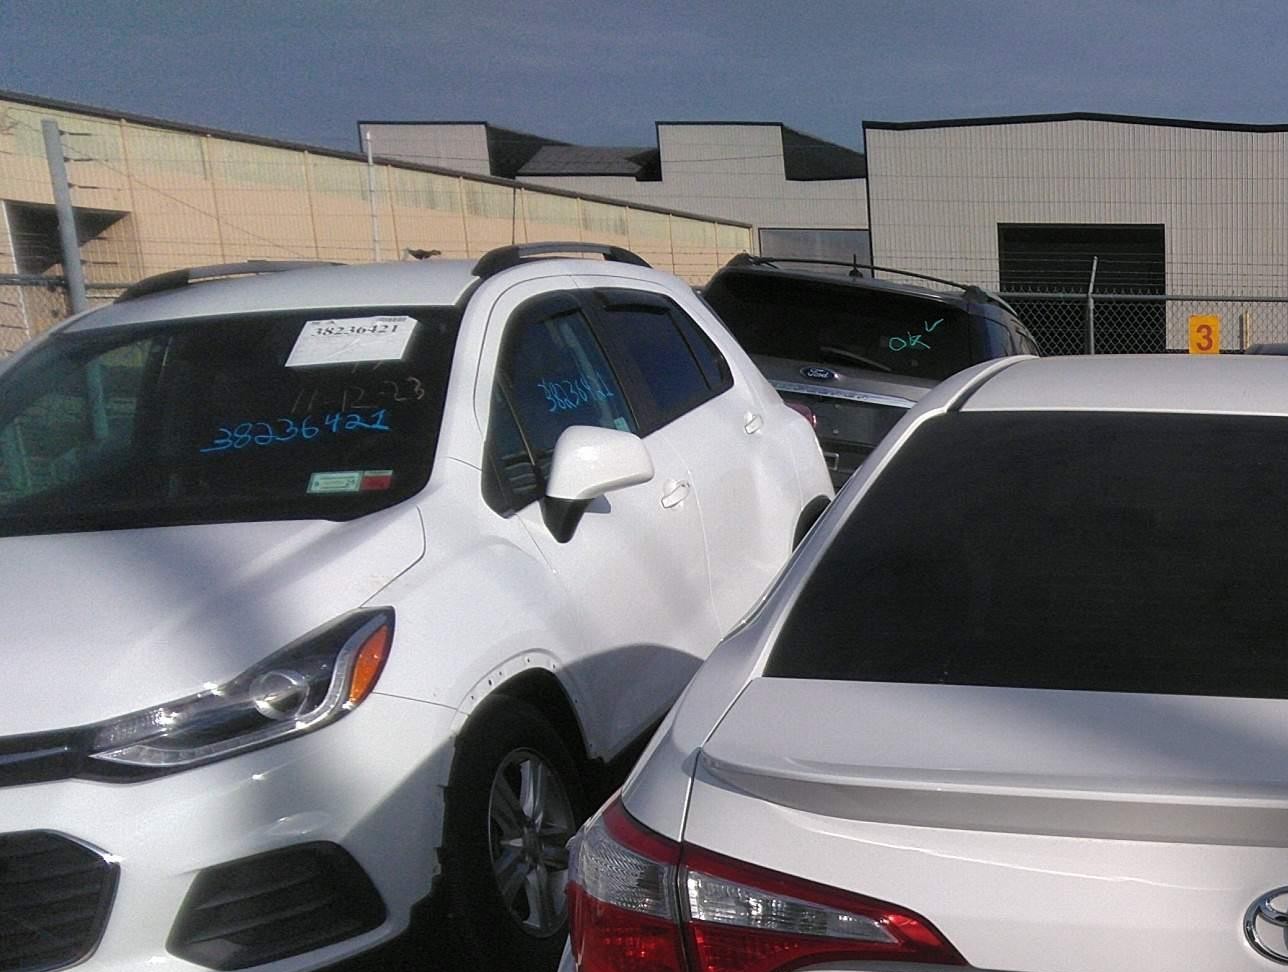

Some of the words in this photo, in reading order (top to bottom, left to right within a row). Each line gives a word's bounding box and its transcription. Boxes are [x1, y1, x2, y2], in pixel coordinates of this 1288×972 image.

[312, 324, 399, 336] 38236421
[889, 331, 931, 351] OK
[1196, 324, 1213, 351] 3
[200, 409, 390, 453] 38236421
